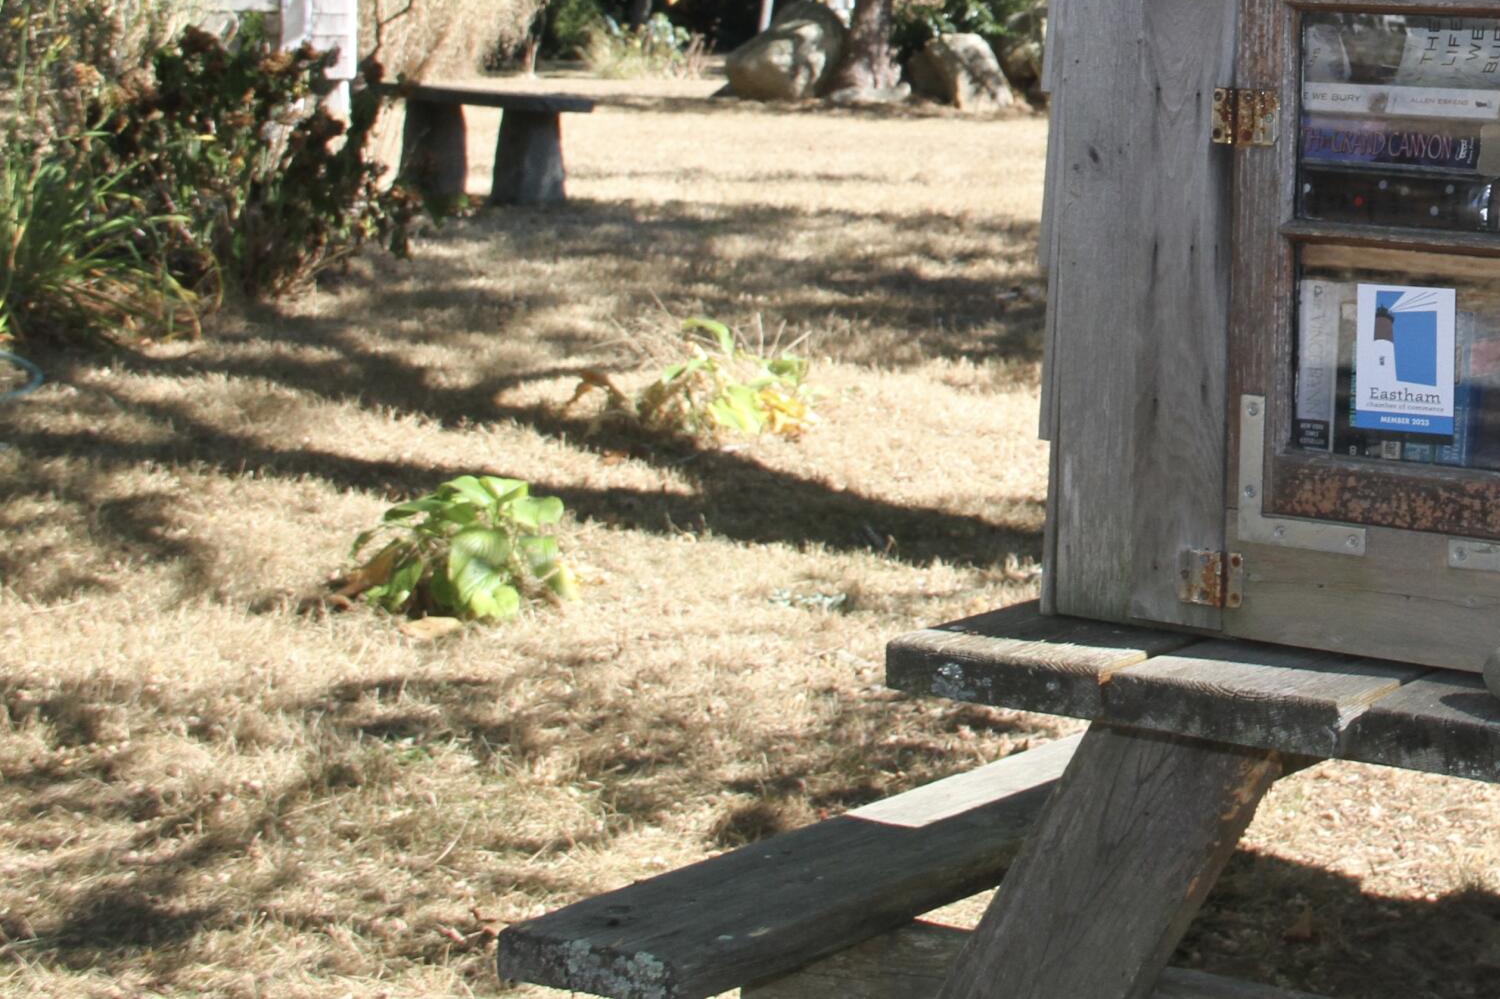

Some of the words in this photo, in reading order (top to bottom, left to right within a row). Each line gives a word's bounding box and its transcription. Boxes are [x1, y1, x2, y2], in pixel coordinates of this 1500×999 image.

[1441, 19, 1462, 66] LIFE
[1465, 25, 1484, 61] WE
[1312, 91, 1328, 101] WE
[1331, 92, 1361, 102] BURY
[1388, 131, 1453, 160] CANYON
[1369, 386, 1441, 404] Eastham
[1366, 401, 1397, 409] chamber
[1407, 404, 1445, 413] commerce
[1380, 415, 1410, 425] MEMBER
